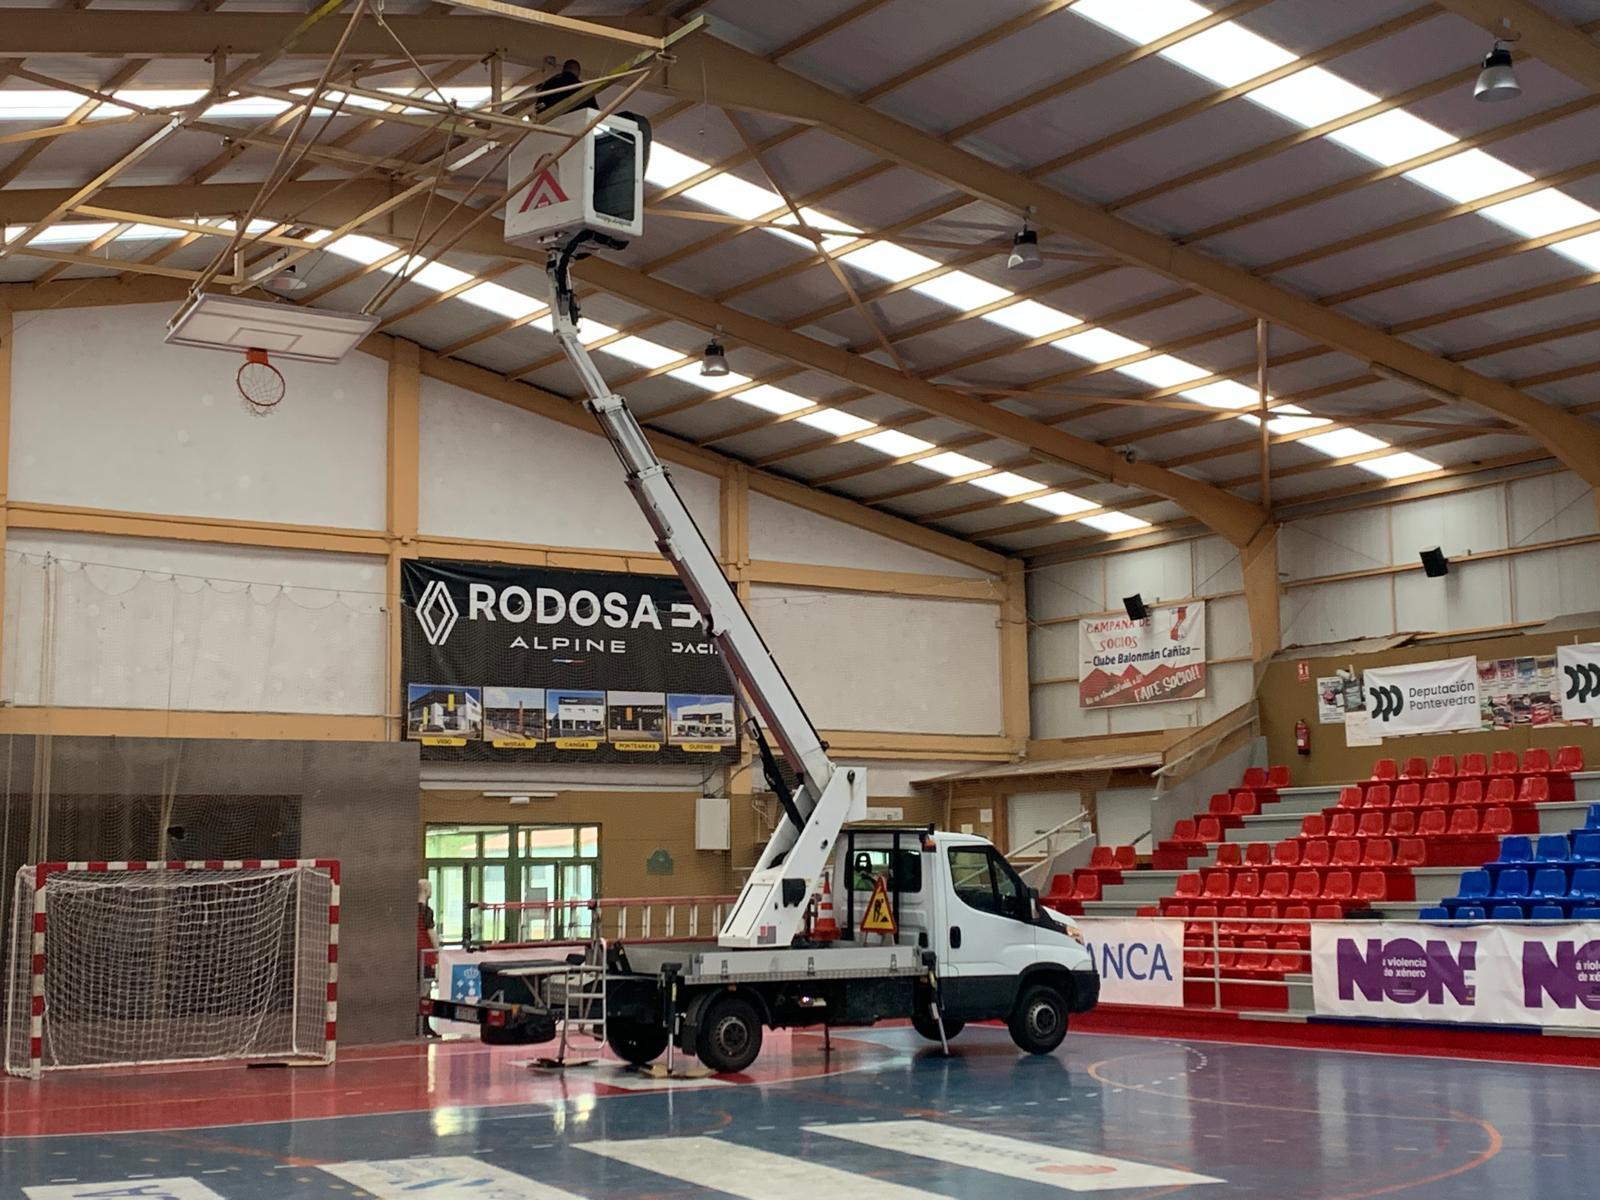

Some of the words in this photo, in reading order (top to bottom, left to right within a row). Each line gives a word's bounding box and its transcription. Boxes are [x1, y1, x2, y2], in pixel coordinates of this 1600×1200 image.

[468, 583, 662, 631] RODOSA
[509, 636, 627, 653] ALPINE
[671, 642, 719, 655] DACI
[1097, 636, 1138, 653] SOCIOS
[1093, 655, 1116, 667] Clube
[1117, 648, 1160, 664] Balonmán
[1162, 645, 1191, 659] Cañiza
[1409, 680, 1475, 699] Deputación
[1409, 695, 1476, 710] Pontevedra
[1387, 956, 1428, 968] violencia
[1395, 967, 1426, 978] xénero
